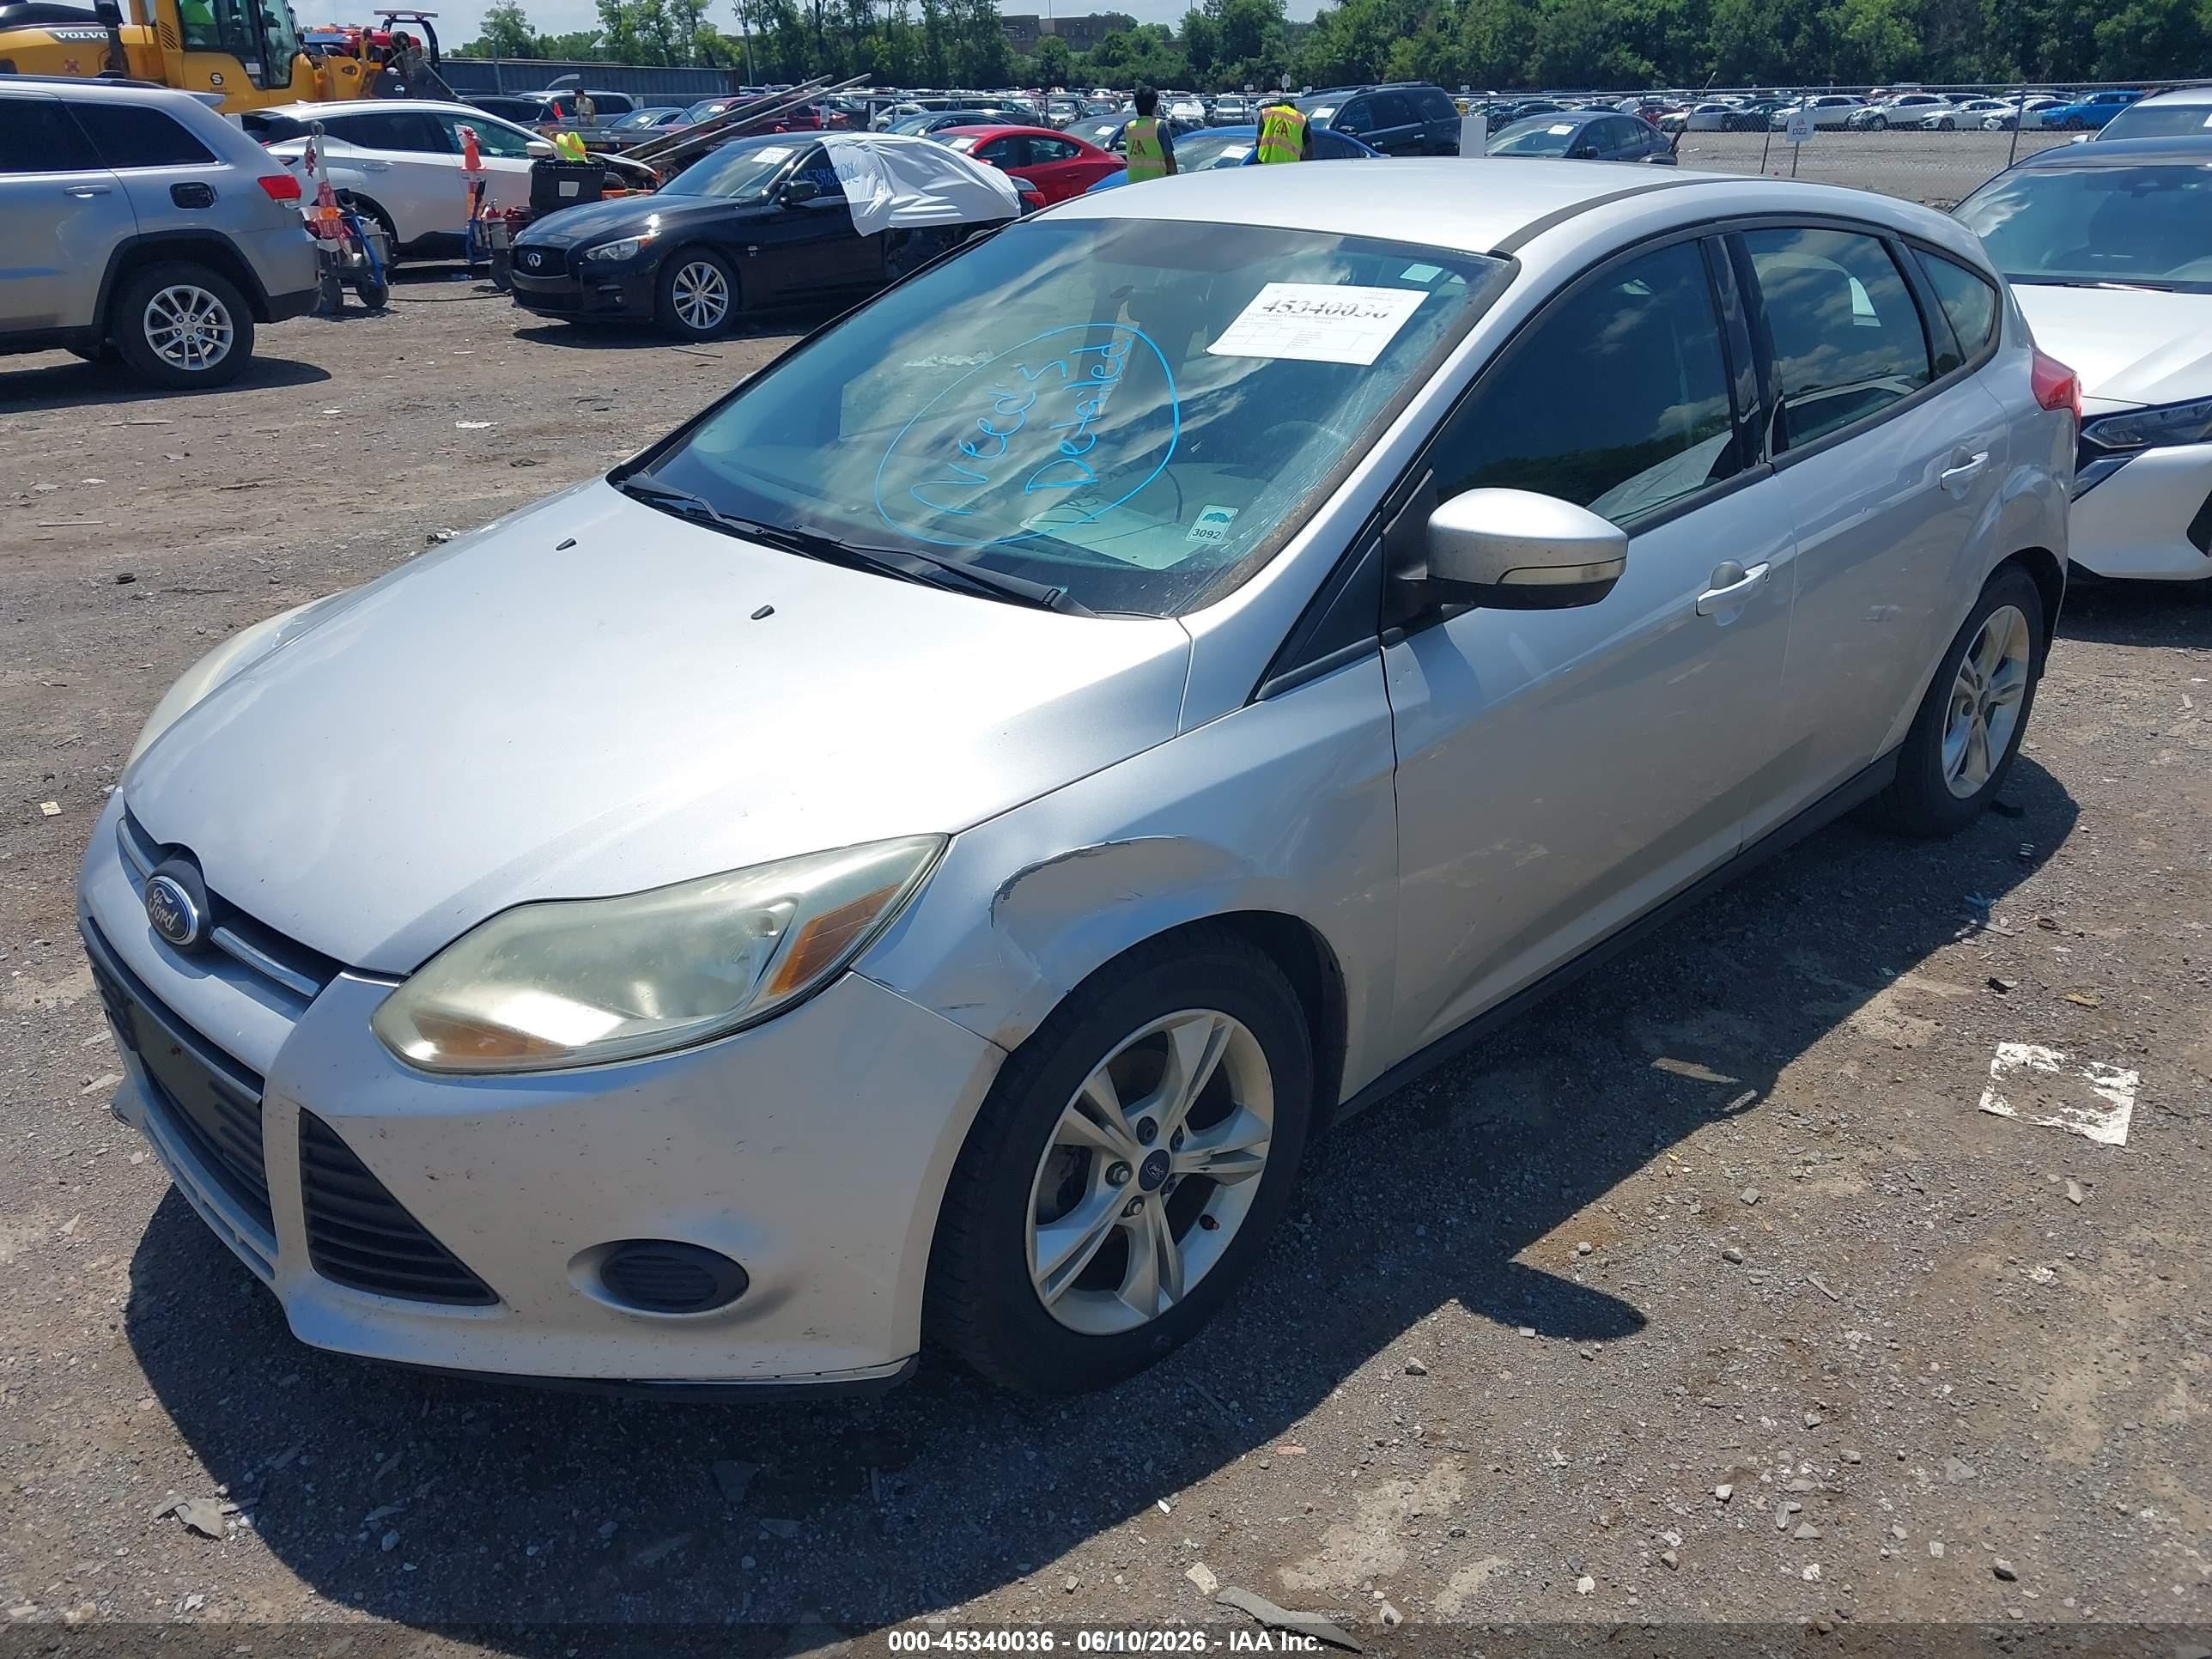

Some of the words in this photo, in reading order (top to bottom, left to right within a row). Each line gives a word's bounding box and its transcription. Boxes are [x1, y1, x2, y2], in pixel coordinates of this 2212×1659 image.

[1023, 337, 1133, 495] Detailed
[1192, 528, 1221, 540] 3092
[149, 886, 179, 932] Ford
